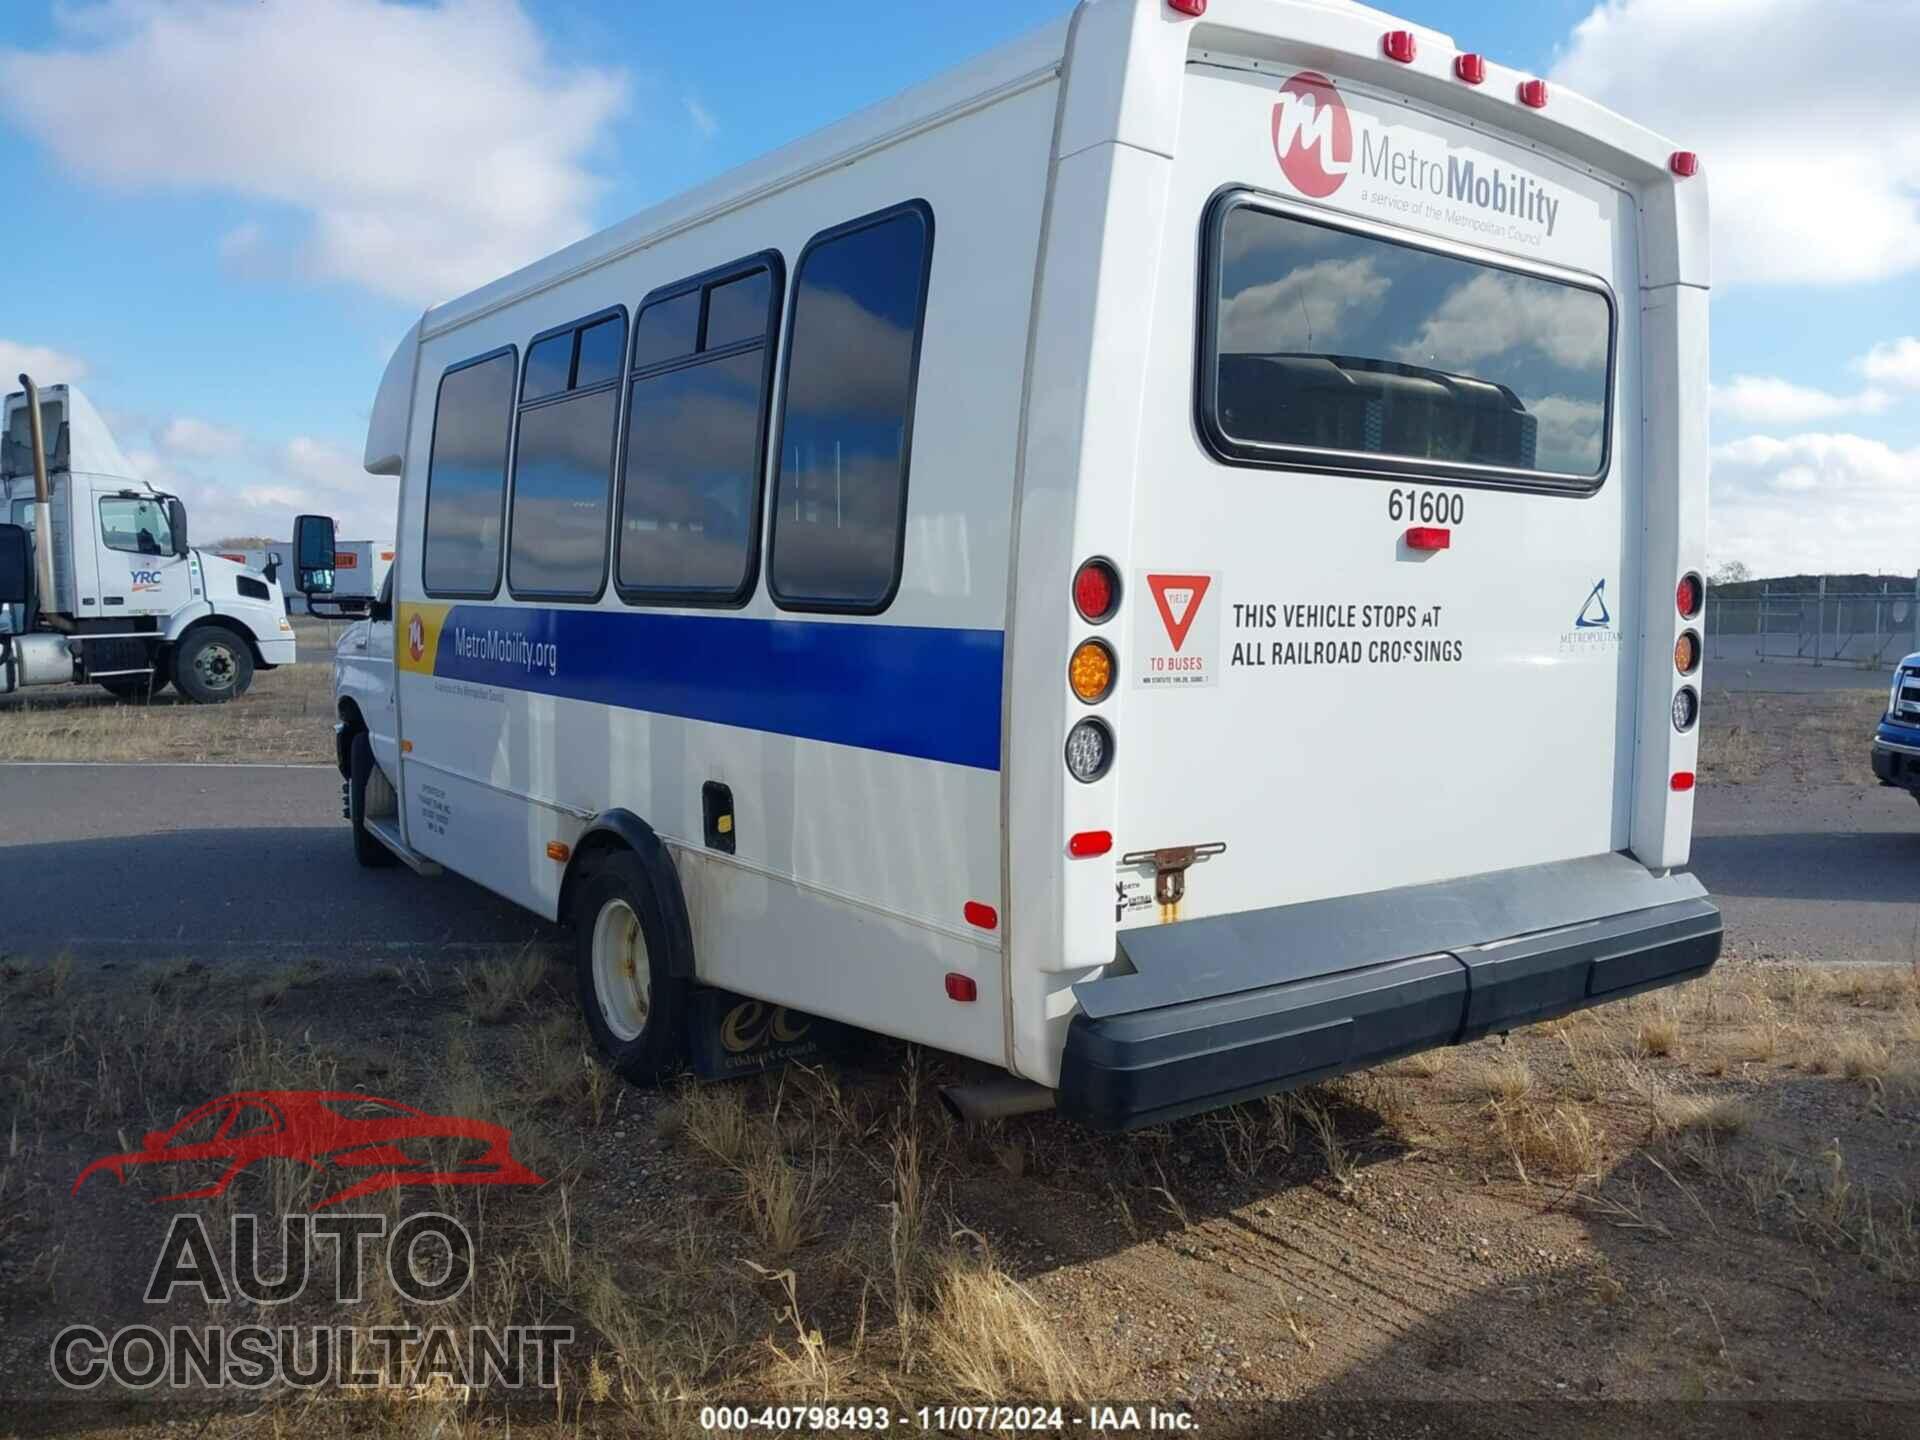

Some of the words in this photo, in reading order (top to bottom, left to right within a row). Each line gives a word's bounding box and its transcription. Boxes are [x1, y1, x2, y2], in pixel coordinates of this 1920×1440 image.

[1361, 128, 1559, 237] MetroMobility
[1360, 190, 1368, 201] a
[1371, 192, 1409, 211] service
[1411, 200, 1422, 215] of
[1425, 204, 1443, 221] the
[1388, 488, 1464, 525] 61600
[131, 571, 161, 584] YRC
[1233, 604, 1277, 628] THIS
[1283, 604, 1356, 628] VEHICLE
[1361, 604, 1417, 628] STOPS
[1421, 606, 1442, 628] AT
[455, 627, 557, 676] MetroMobility.org
[1151, 657, 1164, 671] TO
[1167, 657, 1203, 671] BUSES
[1231, 642, 1266, 667] ALL
[1272, 641, 1362, 666] RAILROAD
[1368, 639, 1463, 664] CROSSINGS
